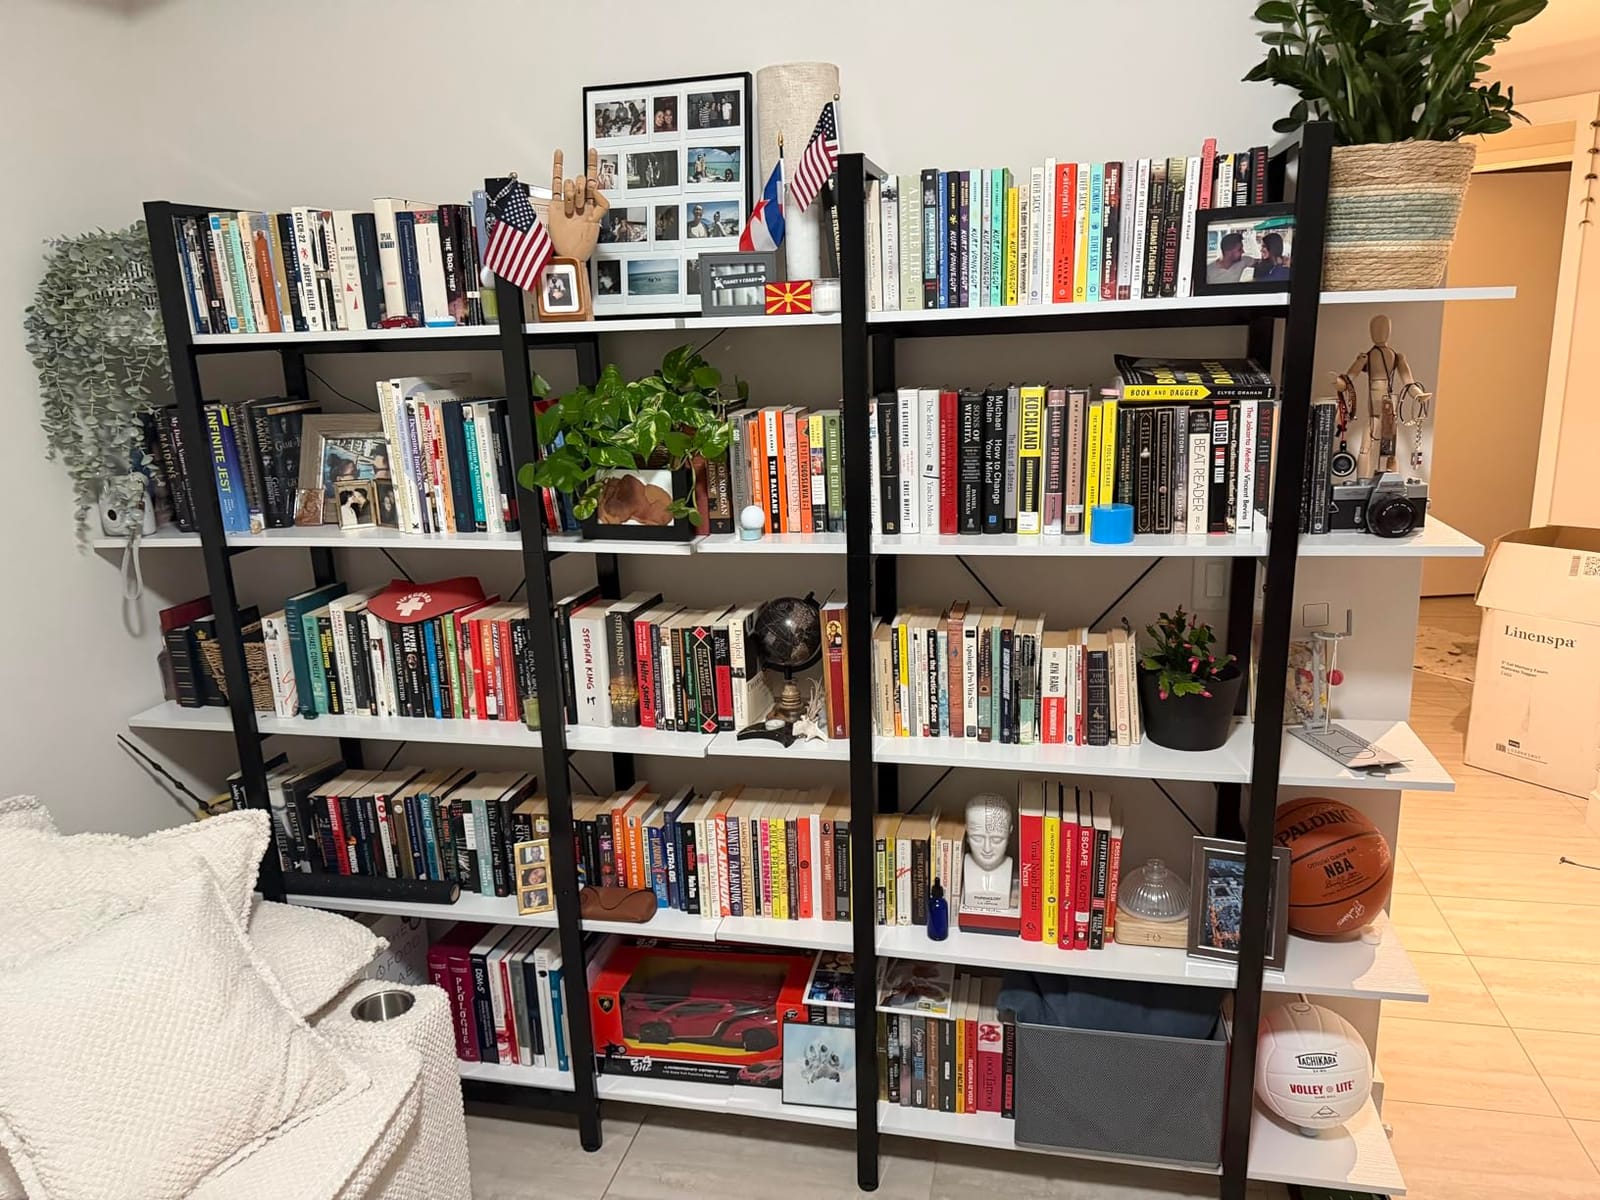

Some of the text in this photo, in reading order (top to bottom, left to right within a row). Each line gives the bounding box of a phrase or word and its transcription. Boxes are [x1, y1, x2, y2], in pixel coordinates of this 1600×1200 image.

[244, 241, 253, 260] Dead
[929, 232, 935, 241] SO
[295, 212, 316, 311] CATCH-22 JOSEPH HELLER
[992, 230, 1001, 290] KURT VONNEGUT
[1164, 228, 1176, 282] KITE RUNNER
[247, 262, 255, 283] Souls
[982, 252, 990, 290] VONNEGUT
[925, 414, 934, 440] Identity
[986, 395, 1003, 430] Michael Pollan
[1024, 397, 1039, 450] KOCHLAND
[174, 430, 182, 446] Dark
[254, 417, 266, 452] MARTIN
[973, 429, 980, 442] OF
[1008, 434, 1016, 444] The
[1215, 423, 1227, 442] LOGO
[206, 412, 231, 493] INFINITE JEST
[409, 418, 424, 490] Designing Interfaces
[924, 442, 934, 458] Trap
[985, 440, 993, 460] Your
[1244, 447, 1252, 472] Method
[801, 461, 810, 498] YUGOSLAVIA
[831, 476, 839, 487] COLD
[992, 440, 1002, 504] How to Change
[1192, 439, 1206, 512] BEAT READER
[792, 478, 800, 512] GHOSTS
[348, 624, 356, 641] david
[402, 626, 411, 652] WELSH
[614, 614, 624, 666] STEPHEN KING
[735, 630, 743, 659] Divided
[1504, 625, 1575, 649] Linenspa
[307, 626, 320, 679] MICHAEL CONNELLY
[484, 639, 492, 666] MARTIAN
[582, 628, 594, 690] STEPHEN KING
[393, 642, 405, 701] AMERICAN PSYCHO
[1049, 663, 1059, 692] AYN RAND
[1276, 808, 1356, 847] PALDING
[347, 845, 359, 873] WIDOWS
[667, 843, 676, 882] ULTRA 85
[716, 819, 729, 908] PALAHNIUK
[728, 821, 740, 903] HAUNTED PALAHNIUK
[1078, 831, 1089, 911] ESCAPE VELOCITY
[1112, 842, 1120, 870] CROSSING
[1323, 857, 1354, 878] NBA
[742, 856, 750, 910] PALAHNIUK
[1022, 862, 1031, 886] Nexus
[1031, 840, 1039, 910] Yuval Noah Harari
[1098, 861, 1106, 894] DISCIPLINE
[475, 968, 485, 993] DSM-5
[1295, 1053, 1338, 1069] TACHIKARA
[1290, 1081, 1353, 1094] VOLLEY LITE
